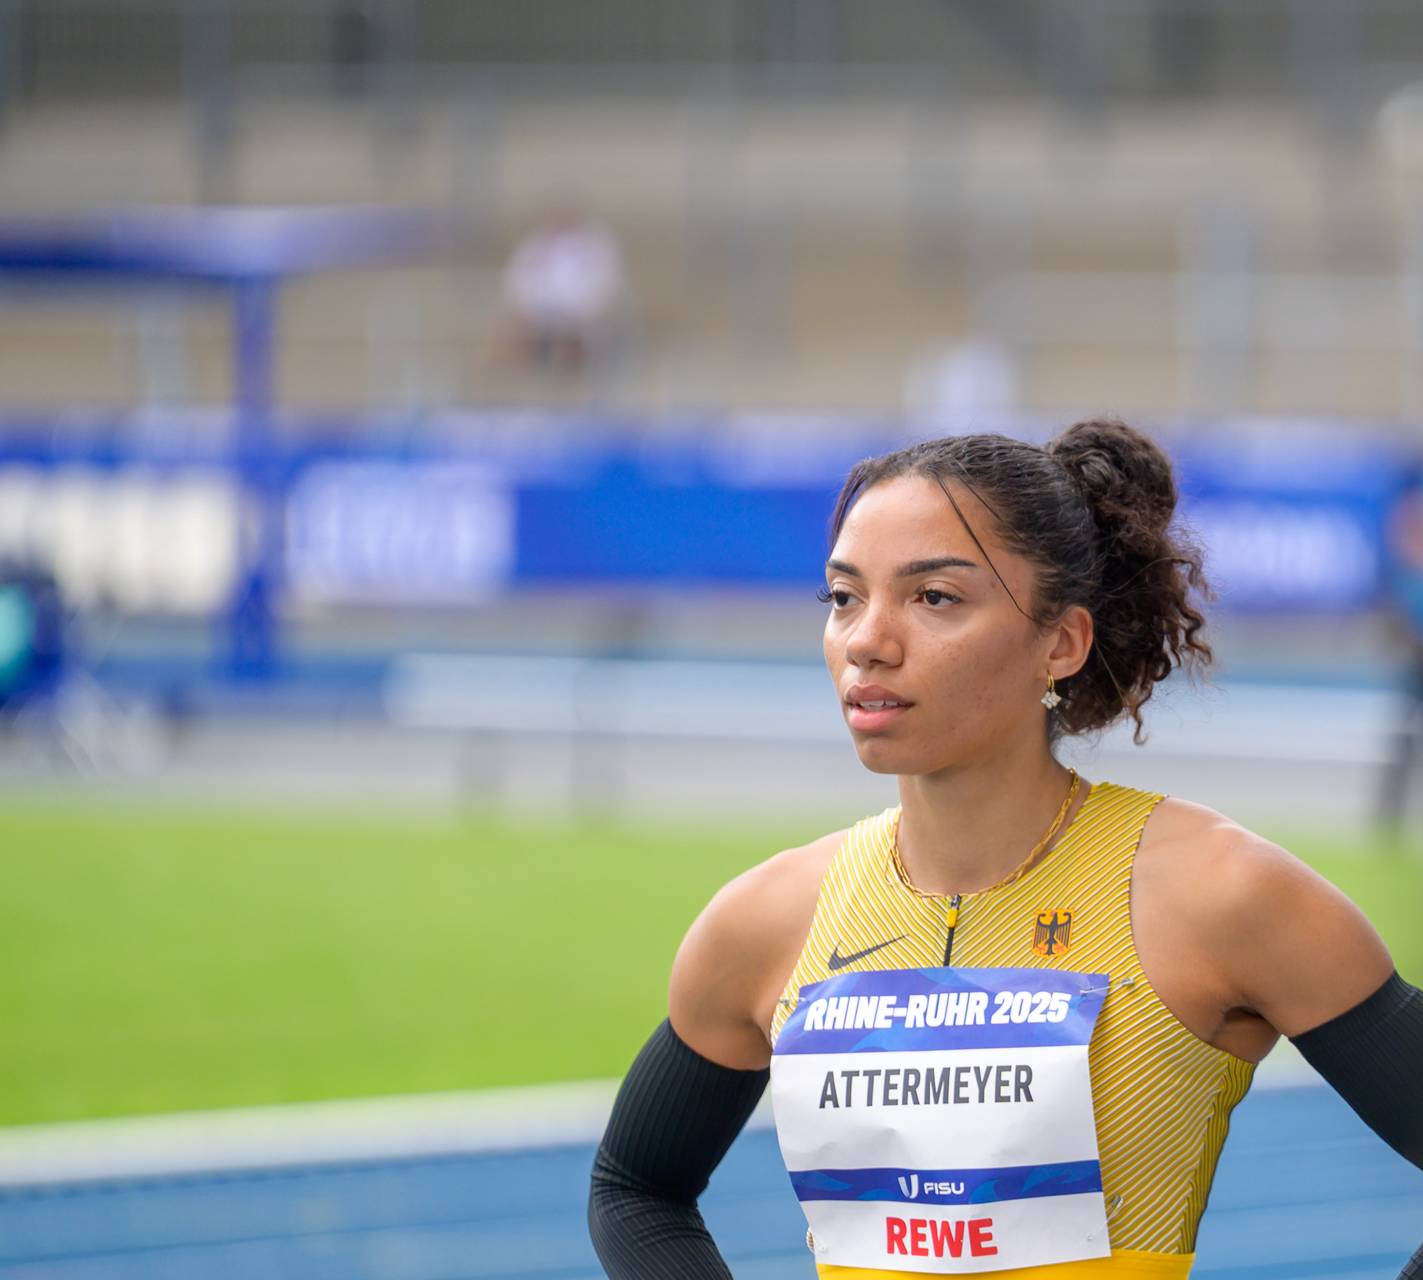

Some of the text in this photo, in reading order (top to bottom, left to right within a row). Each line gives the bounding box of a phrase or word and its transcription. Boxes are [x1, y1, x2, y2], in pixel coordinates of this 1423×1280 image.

[803, 991, 1072, 1031] RHINE-RUHR 2025
[818, 1064, 1034, 1109] ATTERMEYER
[923, 1181, 965, 1196] FISU
[885, 1217, 998, 1258] REWE
